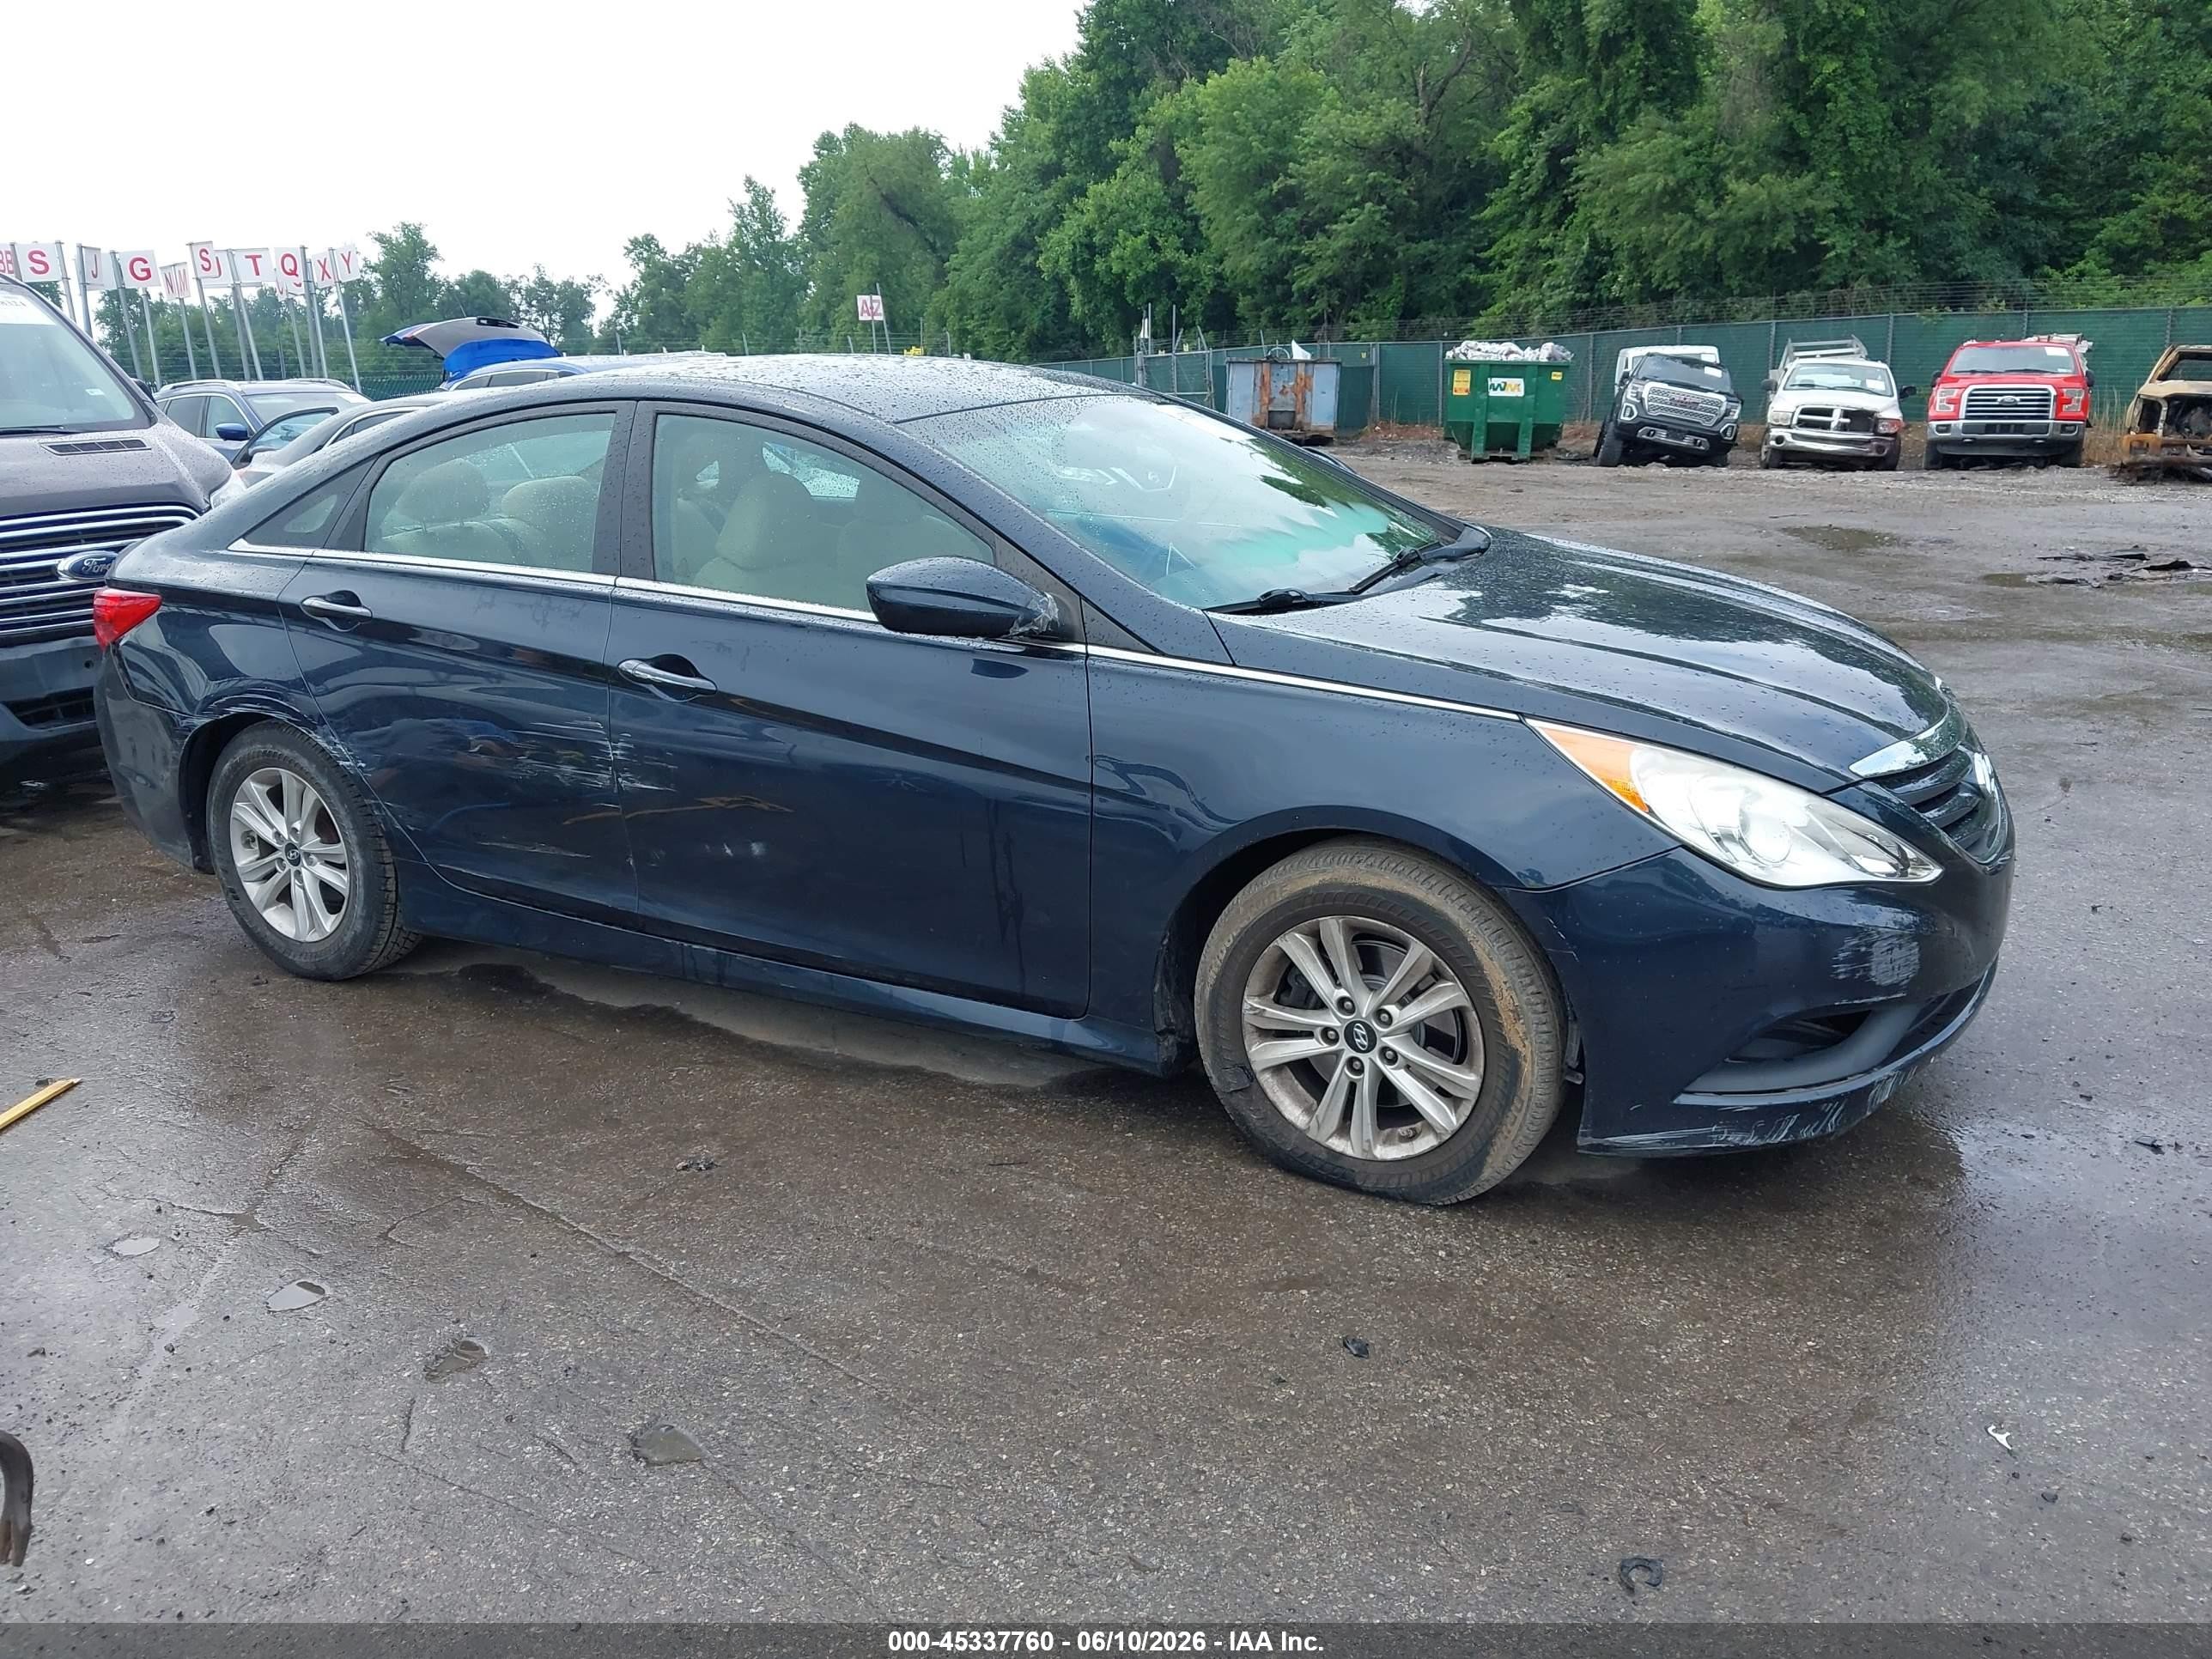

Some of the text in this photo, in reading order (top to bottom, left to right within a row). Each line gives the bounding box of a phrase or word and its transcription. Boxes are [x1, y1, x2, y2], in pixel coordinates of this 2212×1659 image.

[27, 250, 50, 275] S
[89, 253, 98, 278] J
[129, 257, 152, 281] G
[199, 248, 211, 271] S
[245, 254, 262, 276] T
[280, 252, 299, 276] Q
[317, 258, 331, 281] X
[340, 251, 351, 274] Y
